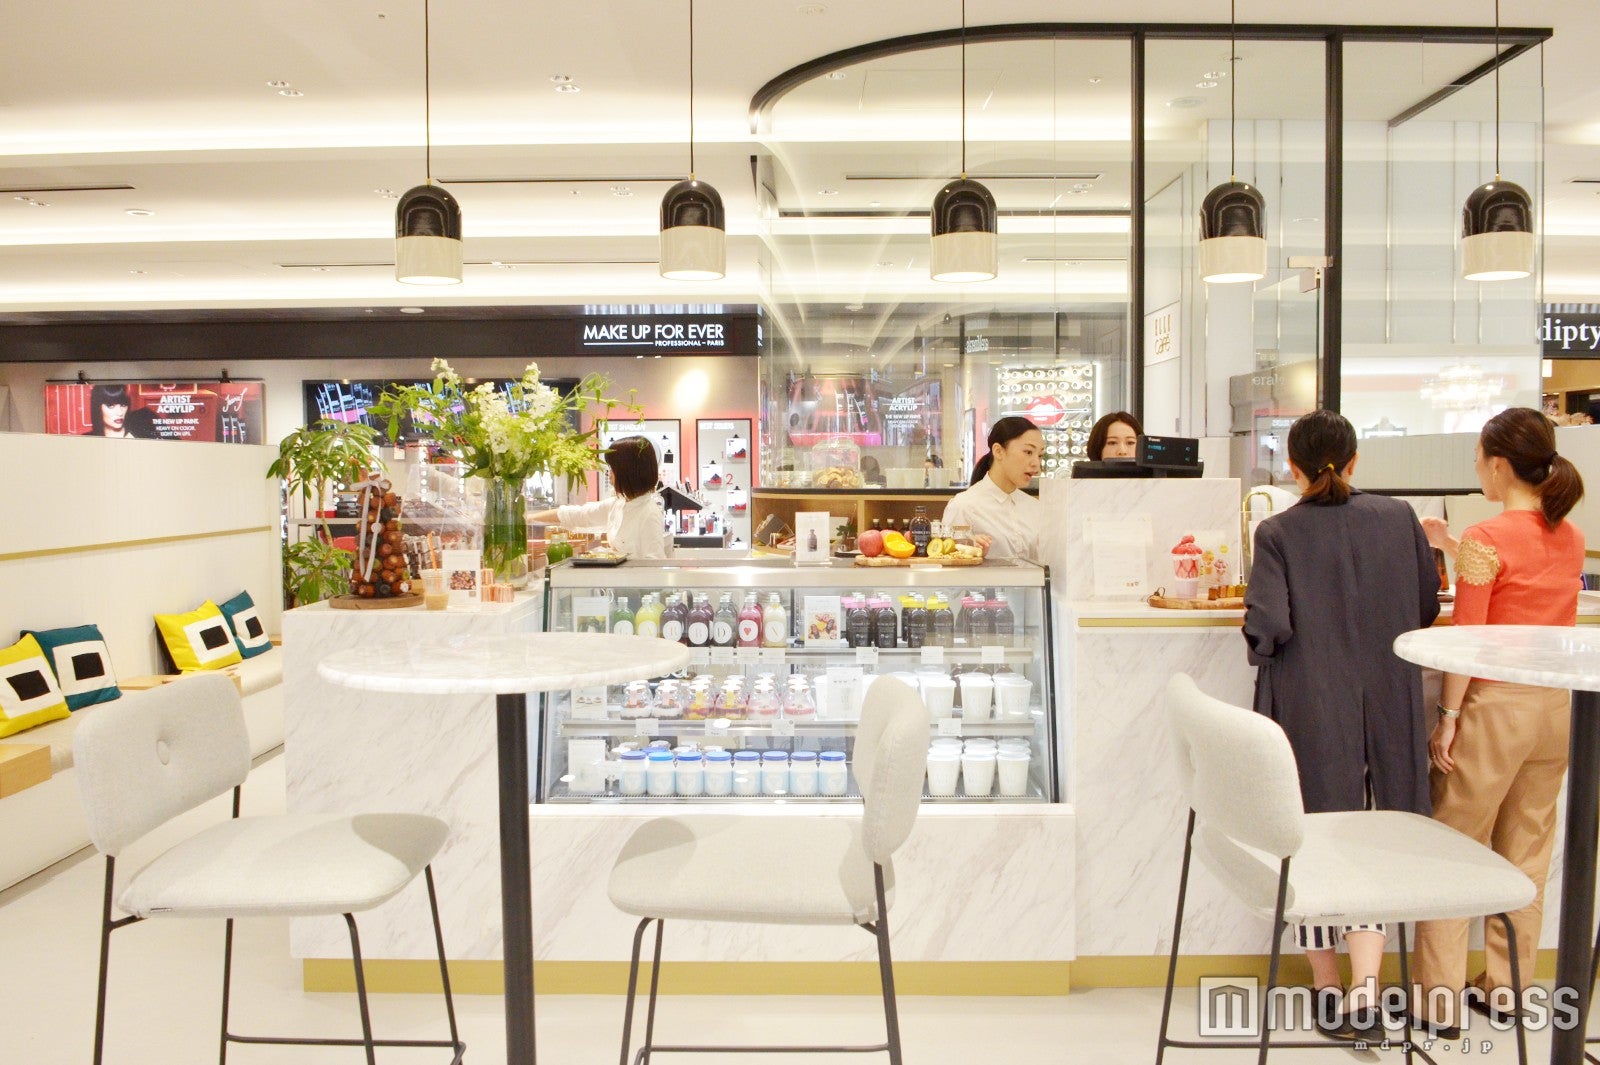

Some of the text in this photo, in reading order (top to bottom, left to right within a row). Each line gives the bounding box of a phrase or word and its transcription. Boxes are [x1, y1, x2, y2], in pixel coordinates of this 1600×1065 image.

[583, 324, 725, 340] MAKE UP FOR EVER
[160, 395, 192, 403] ARTIST
[157, 405, 196, 413] ACRYLIP
[726, 473, 733, 485] 2
